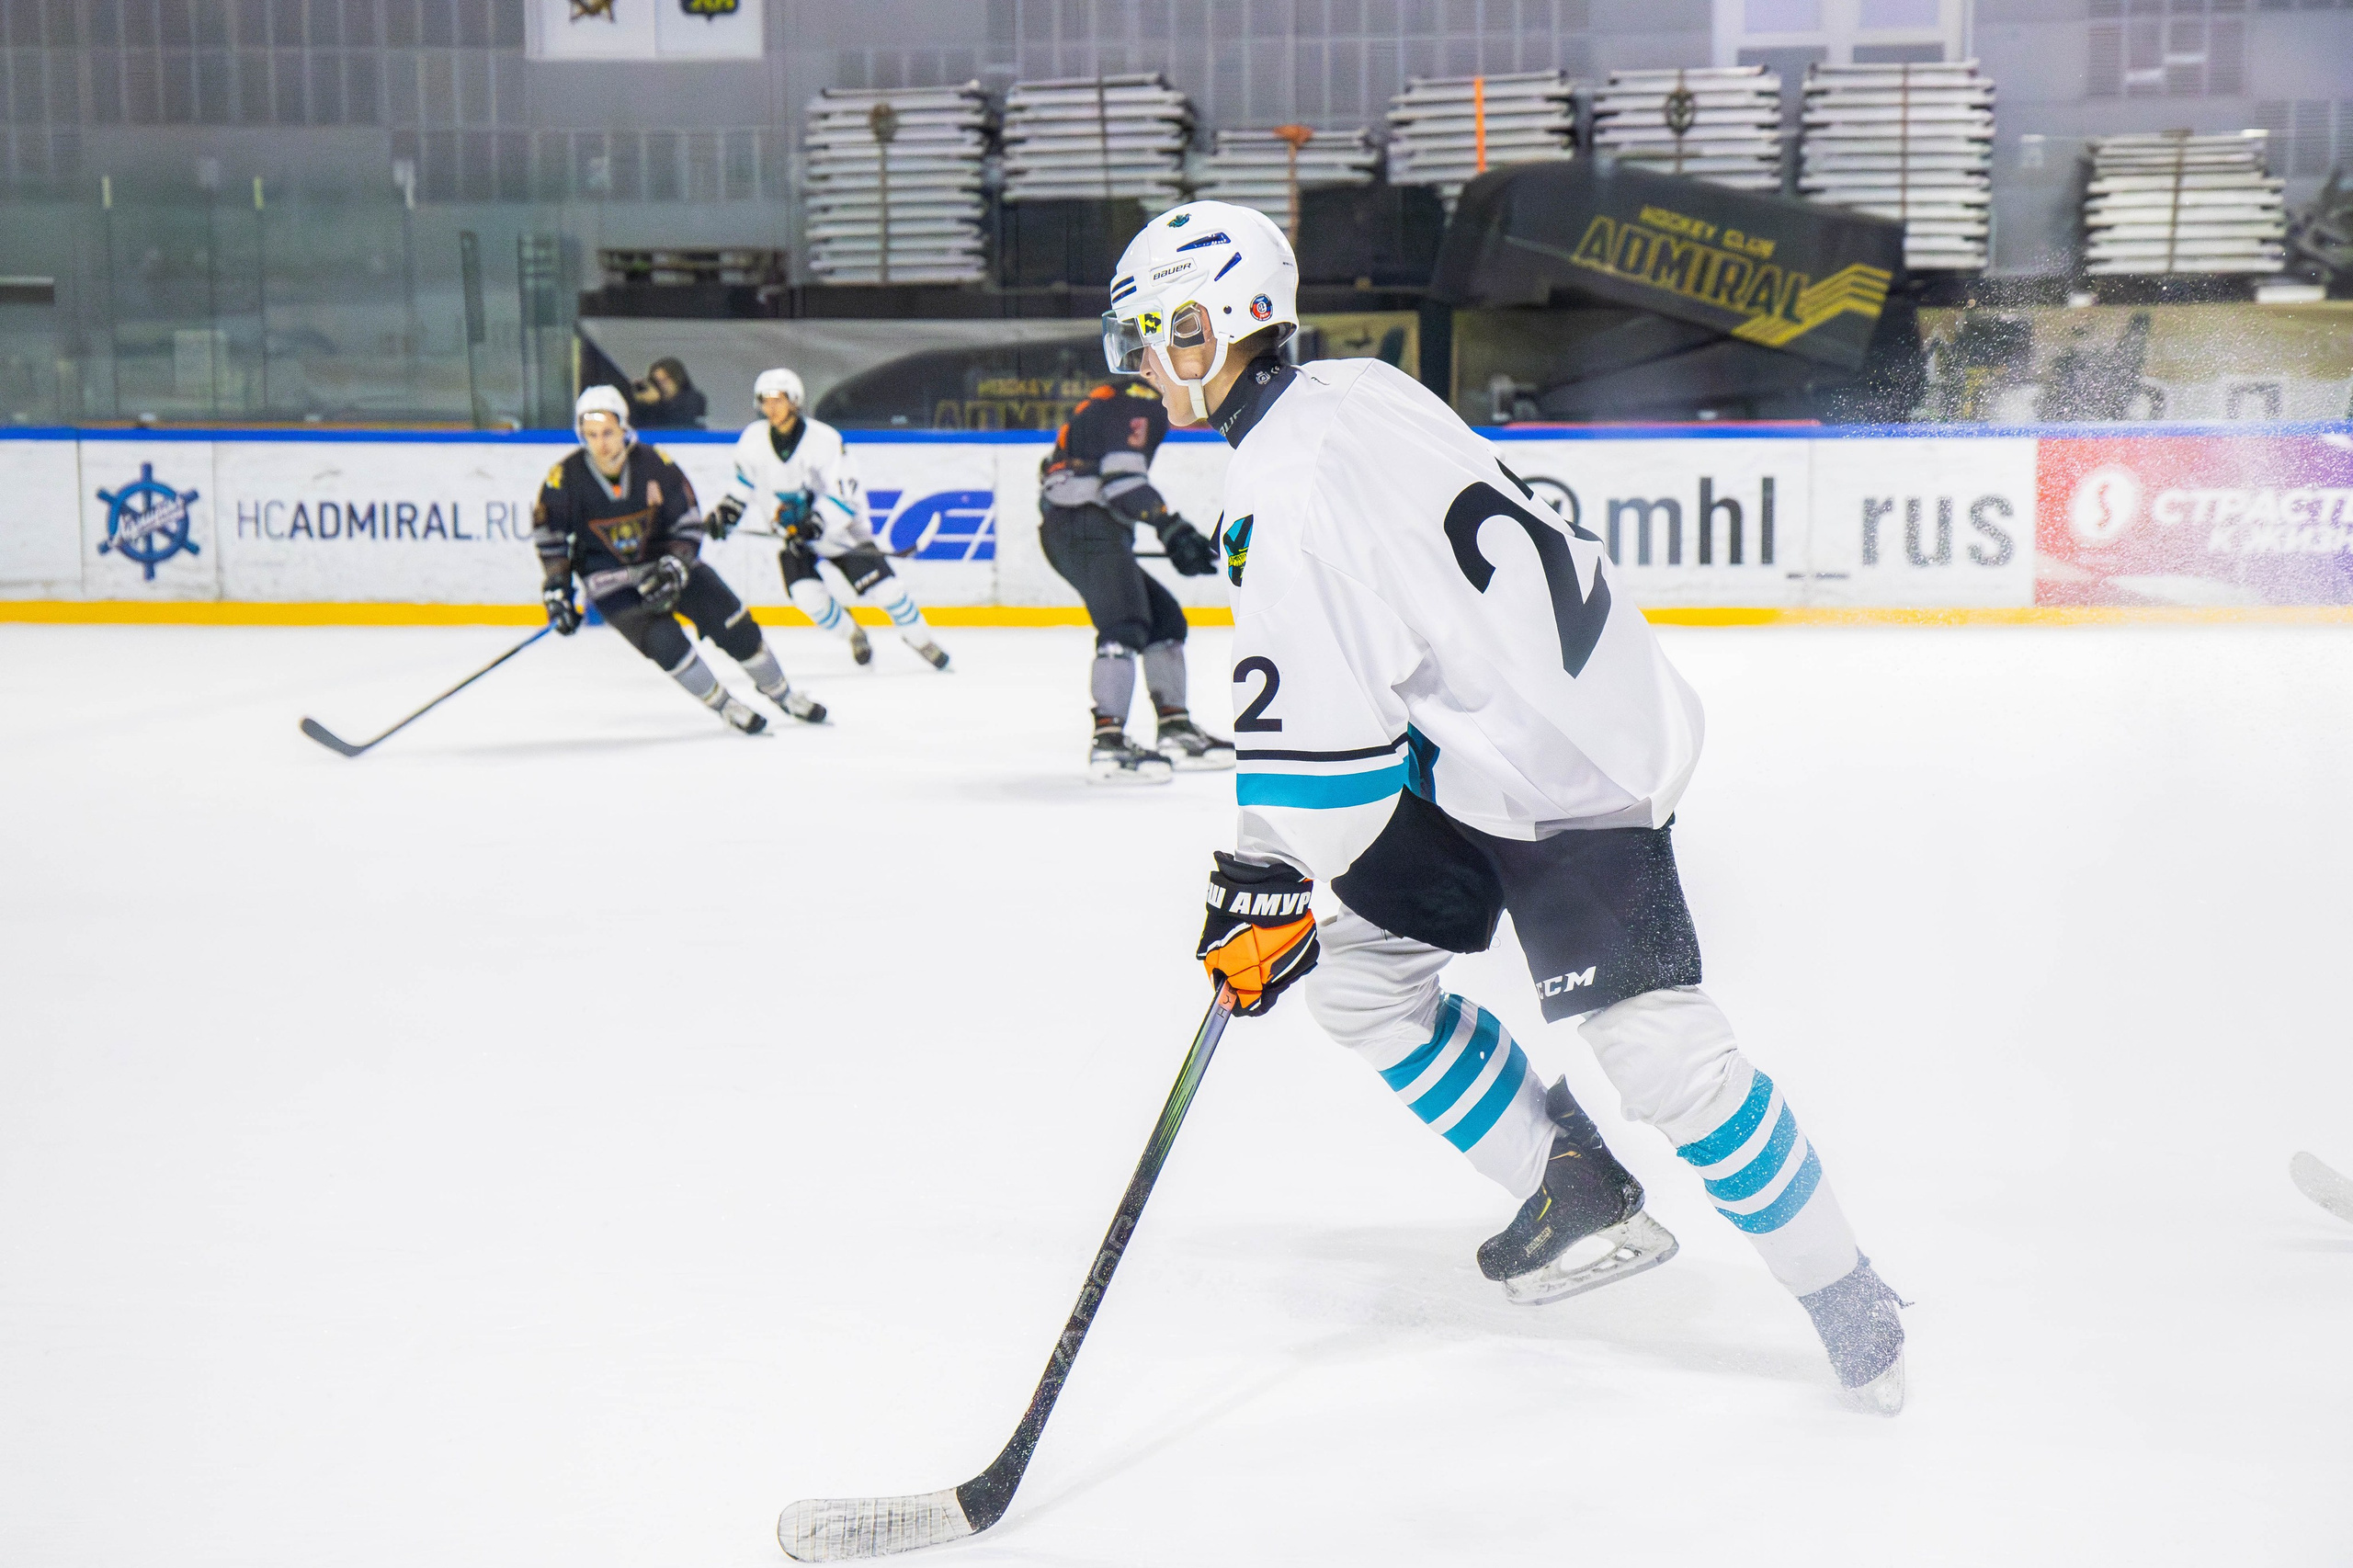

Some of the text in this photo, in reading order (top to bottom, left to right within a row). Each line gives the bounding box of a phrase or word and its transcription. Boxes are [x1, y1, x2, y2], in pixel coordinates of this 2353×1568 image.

[1570, 214, 1811, 324] ADMIRAL
[1126, 415, 1150, 449] 3
[237, 501, 533, 541] HCADMIRAL.RU
[1233, 655, 1283, 733] 2
[1229, 892, 1312, 916] АМУР
[1536, 966, 1597, 999] CCM
